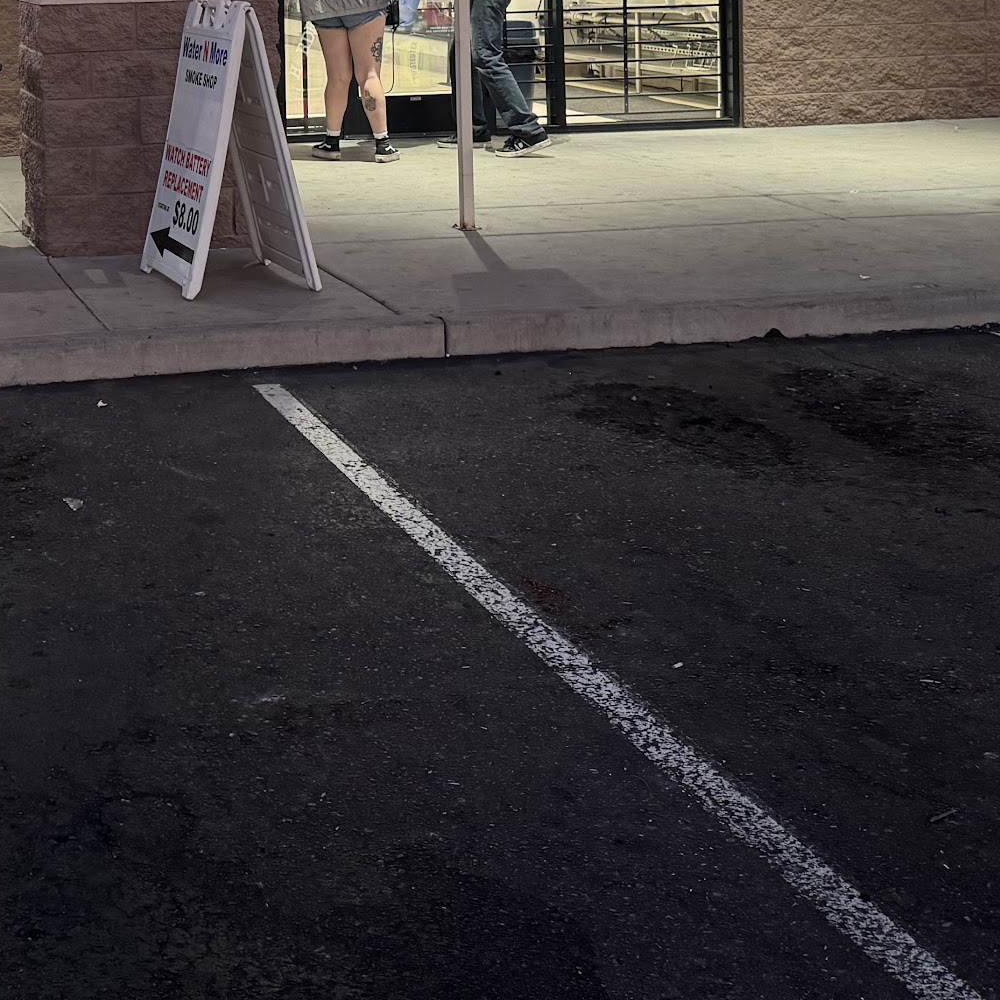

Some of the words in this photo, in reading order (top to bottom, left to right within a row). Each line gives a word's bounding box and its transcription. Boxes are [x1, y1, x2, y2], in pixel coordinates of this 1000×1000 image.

[182, 36, 203, 60] Water
[202, 40, 210, 62] N
[209, 42, 228, 67] More
[185, 69, 203, 86] SMOKE
[203, 73, 217, 90] SHOP
[165, 144, 185, 169] WATCH
[185, 151, 212, 177] BATTERY
[163, 170, 204, 203] REPLACEMENT
[172, 200, 199, 236] $8.00
